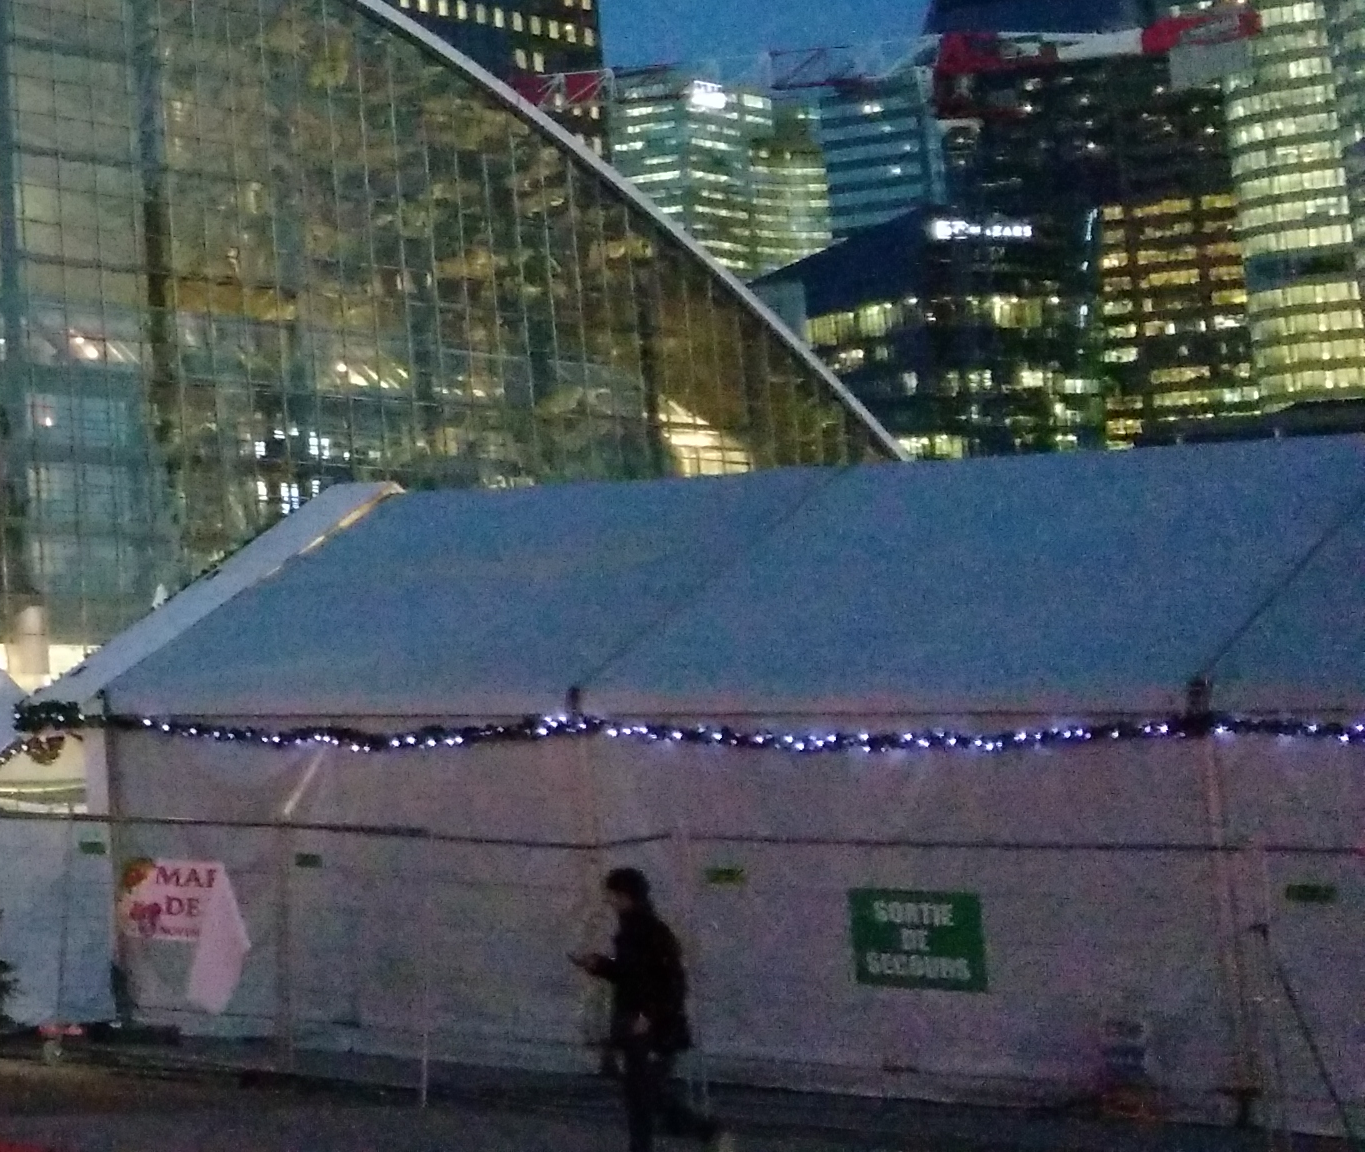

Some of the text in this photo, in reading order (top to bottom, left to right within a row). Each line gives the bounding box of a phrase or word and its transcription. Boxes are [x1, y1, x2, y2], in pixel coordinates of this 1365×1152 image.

[165, 896, 200, 917] DE
[873, 900, 954, 927] SORTIE
[901, 928, 930, 951] DE
[866, 951, 971, 981] SECOURS
